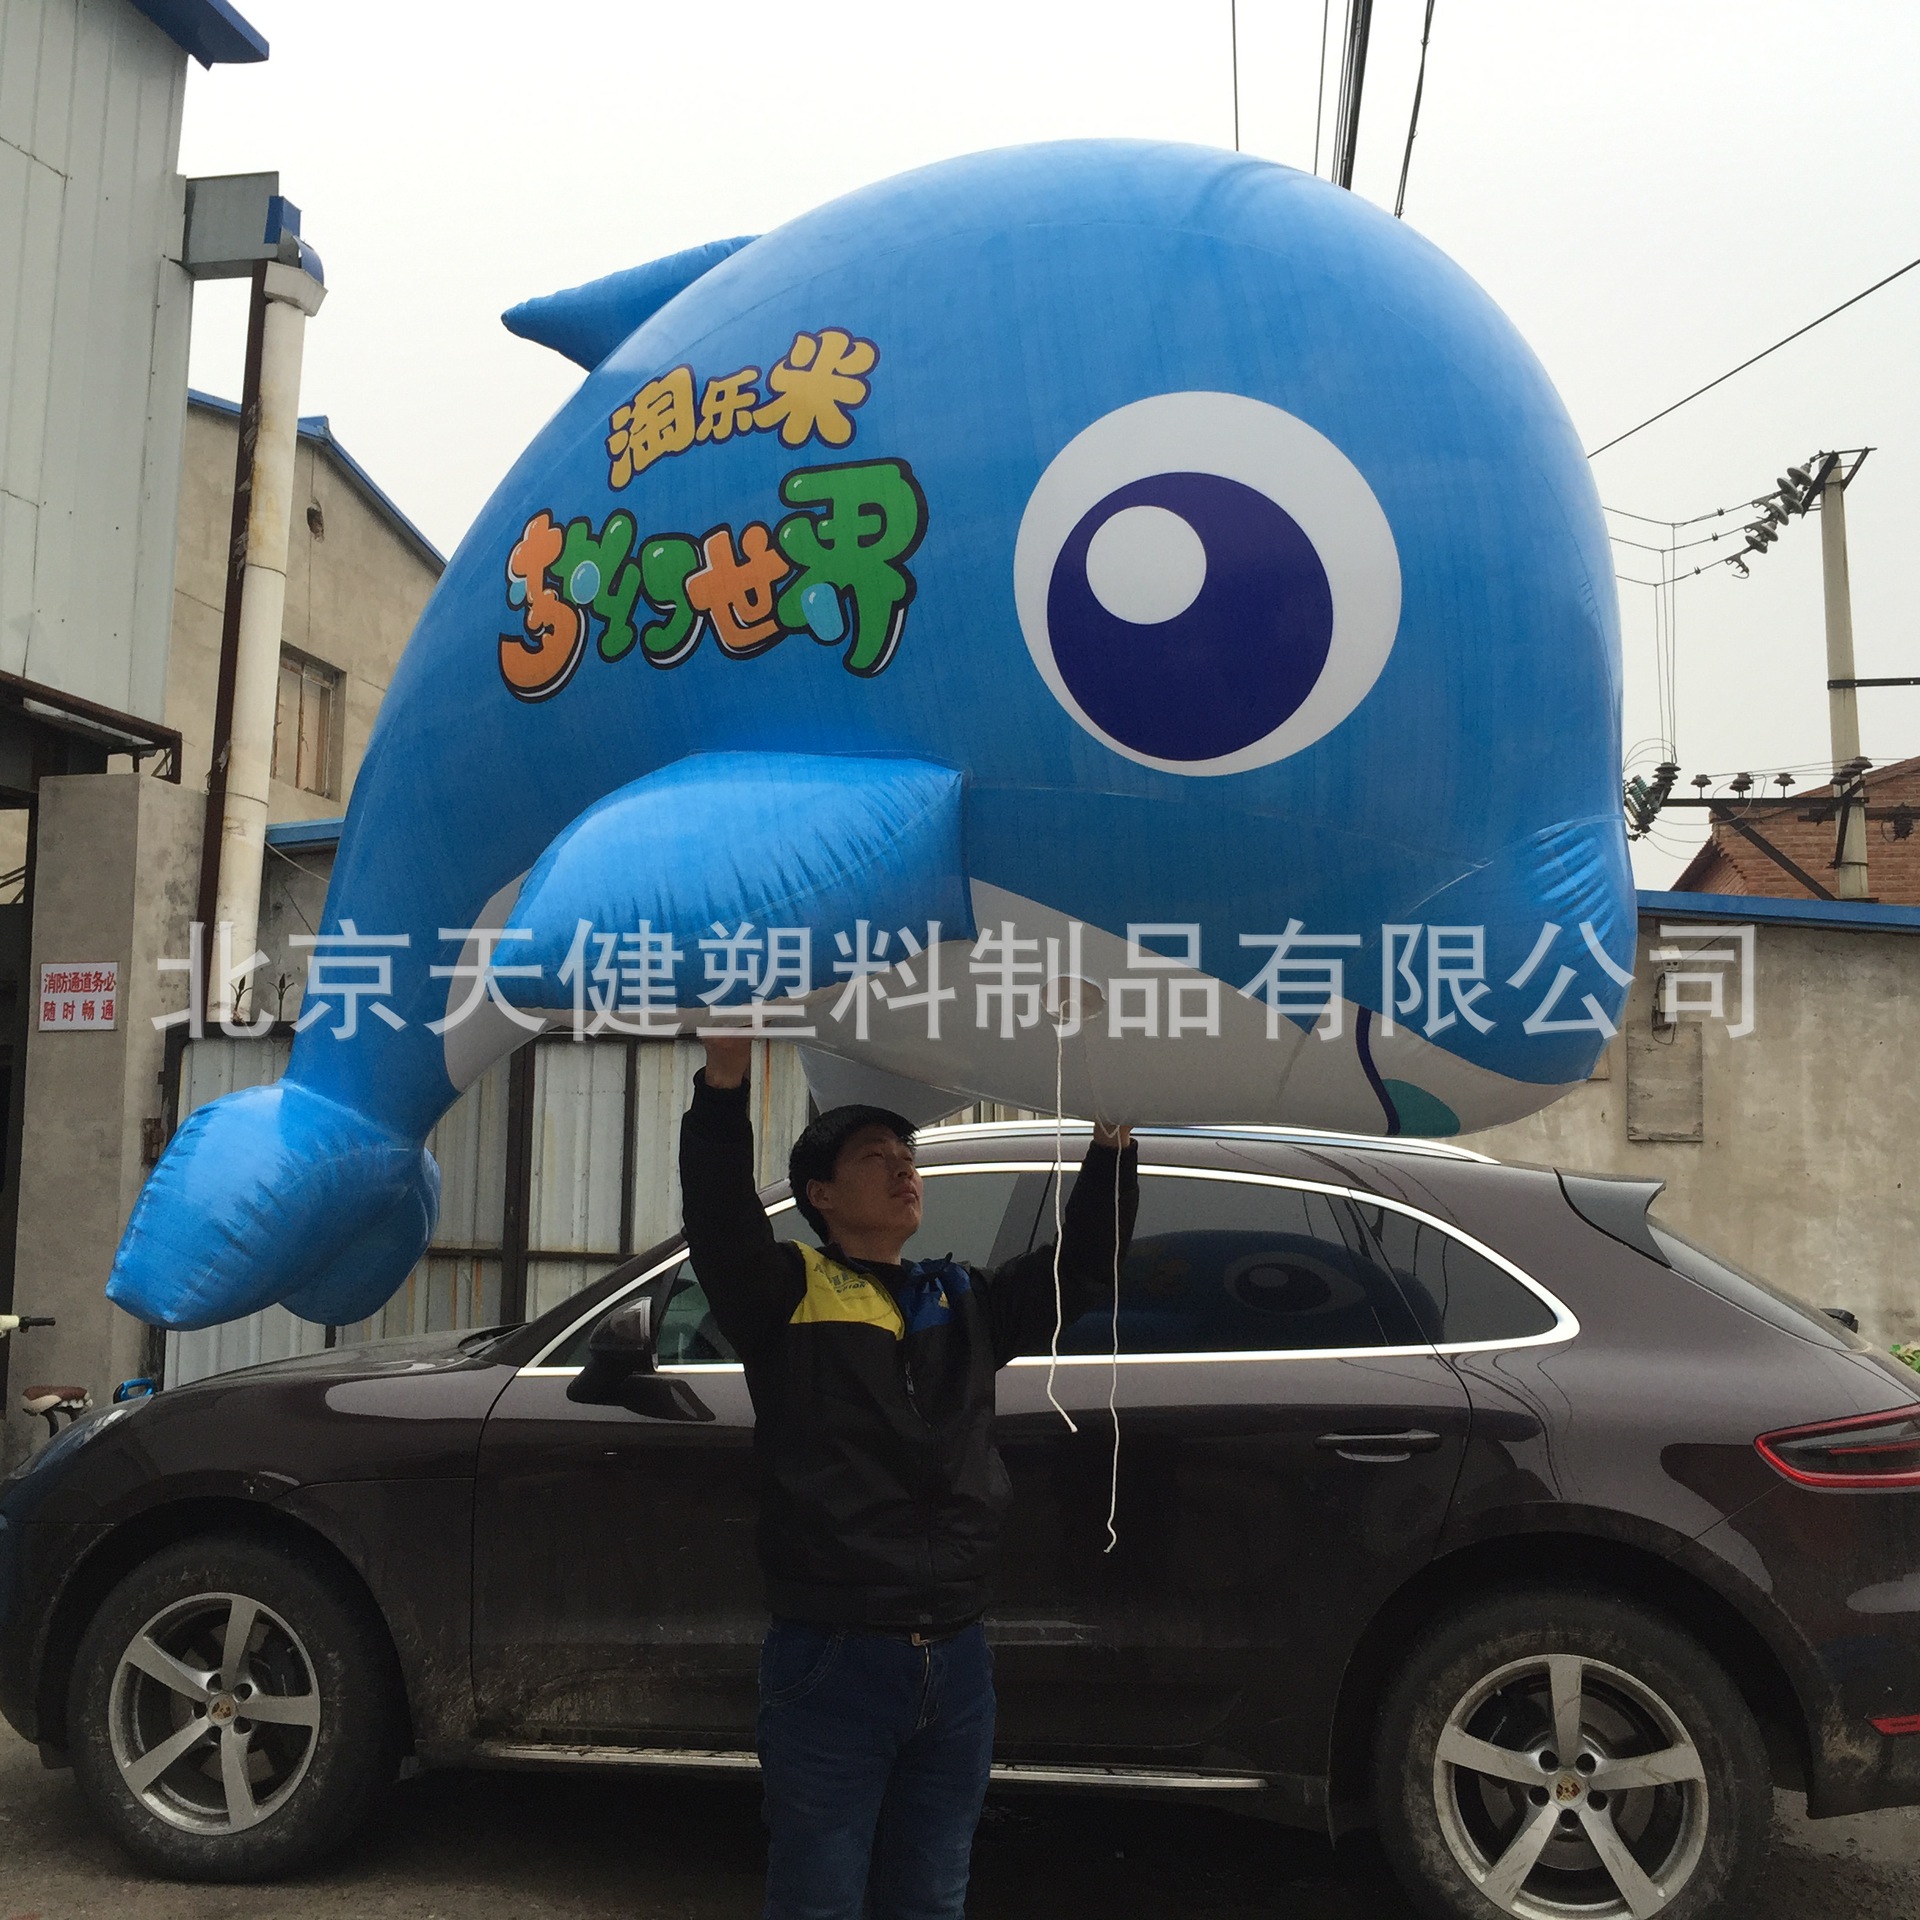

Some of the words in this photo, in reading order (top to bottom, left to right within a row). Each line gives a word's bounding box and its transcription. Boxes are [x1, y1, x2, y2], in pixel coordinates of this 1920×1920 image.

[605, 327, 880, 491] 淘乐米
[43, 970, 116, 994] 消防通道务必
[43, 999, 114, 1022] 随时畅通
